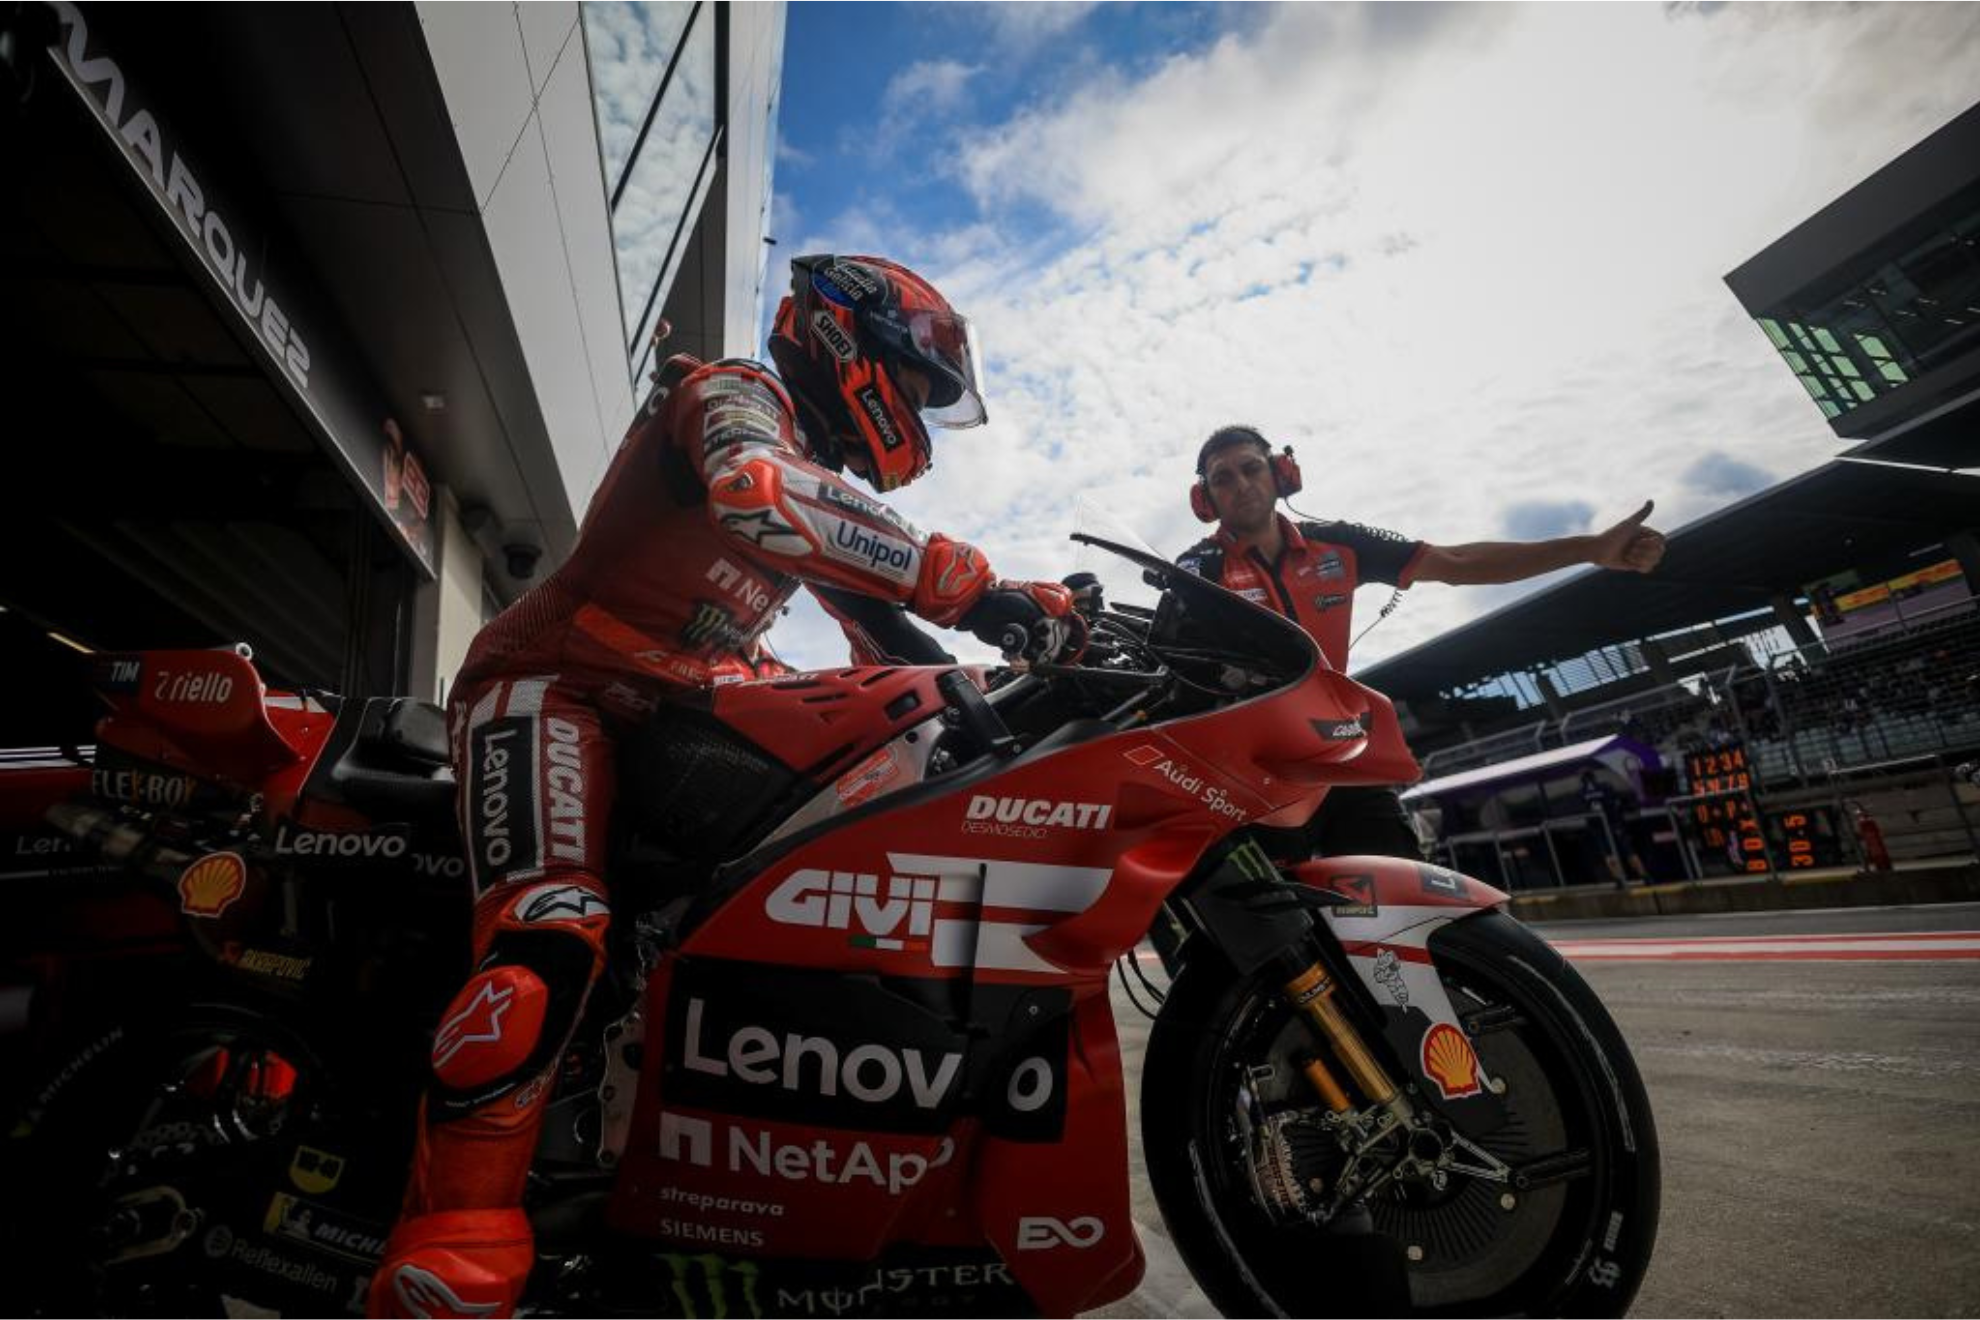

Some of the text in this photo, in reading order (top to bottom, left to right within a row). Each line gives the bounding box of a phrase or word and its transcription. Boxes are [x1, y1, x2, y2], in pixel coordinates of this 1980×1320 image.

[56, 0, 311, 389] MARQUEZ
[815, 314, 853, 357] SHOEI
[861, 388, 898, 447] Lenovo
[836, 521, 913, 571] Unipol
[110, 661, 140, 683] TIM
[482, 728, 518, 868] Lenovo
[546, 716, 586, 865] DUCATI
[966, 795, 1113, 830] DUCATI
[1153, 759, 1248, 822] Audi Sport
[275, 826, 407, 858] Lenovo
[765, 868, 936, 937] GIVI
[682, 998, 1055, 1113] Lenovo
[659, 1186, 785, 1217] streparava
[659, 1218, 766, 1248] SIEMENS
